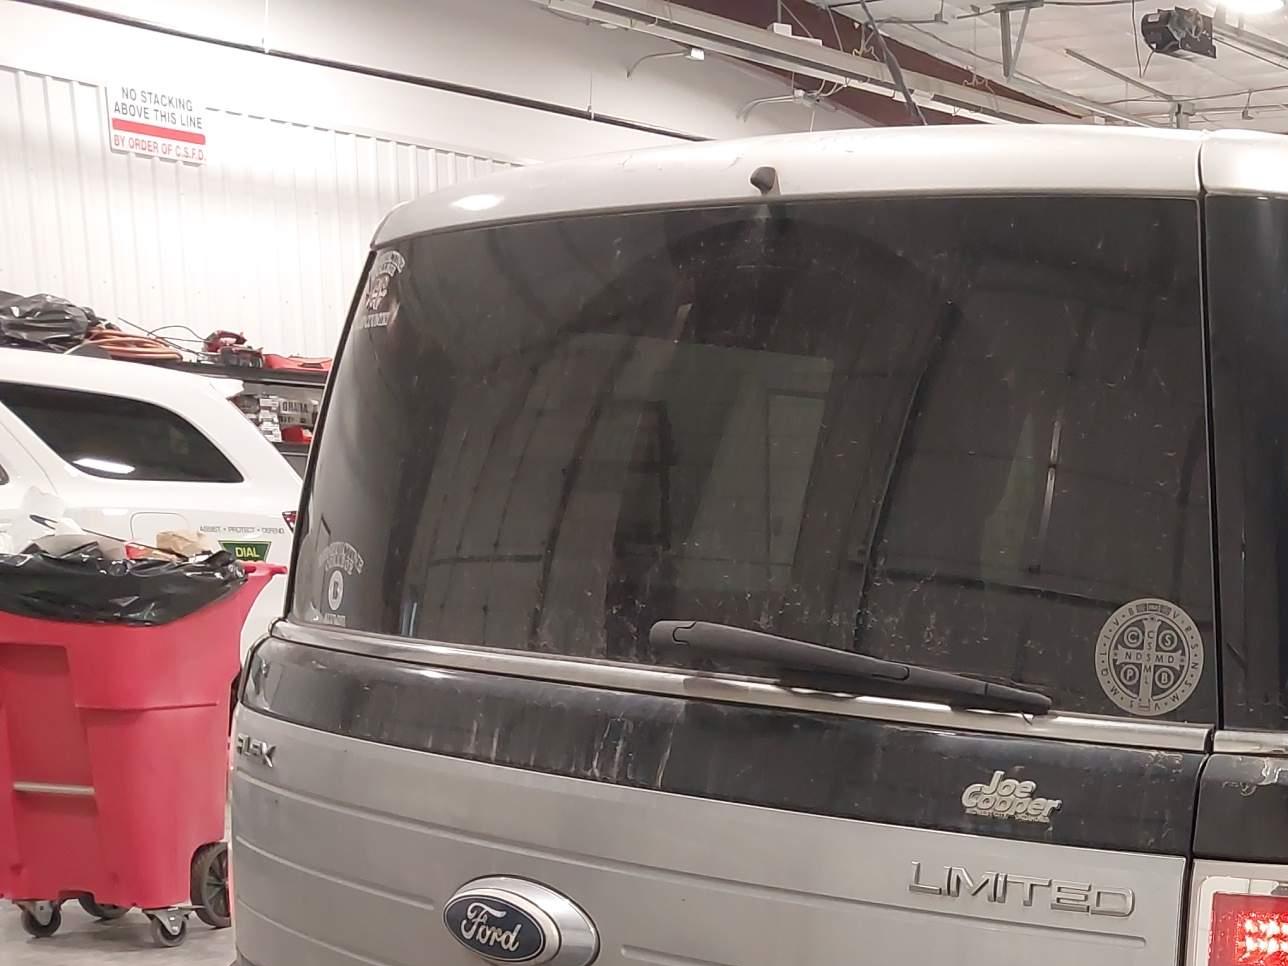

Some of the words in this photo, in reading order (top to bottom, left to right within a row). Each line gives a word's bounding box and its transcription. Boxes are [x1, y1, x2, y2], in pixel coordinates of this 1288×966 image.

[122, 87, 137, 101] NO
[141, 90, 193, 112] STACKING
[114, 101, 150, 120] ABOVE
[153, 109, 177, 125] THIS
[180, 115, 203, 130] LINE
[114, 134, 126, 148] BY
[128, 137, 159, 153] ORDER
[162, 143, 173, 156] OF
[235, 546, 260, 558] DIAL
[980, 769, 1037, 799] Joe
[961, 783, 1063, 818] Cooper
[908, 860, 1136, 918] LIMITED
[460, 902, 522, 952] Ford
